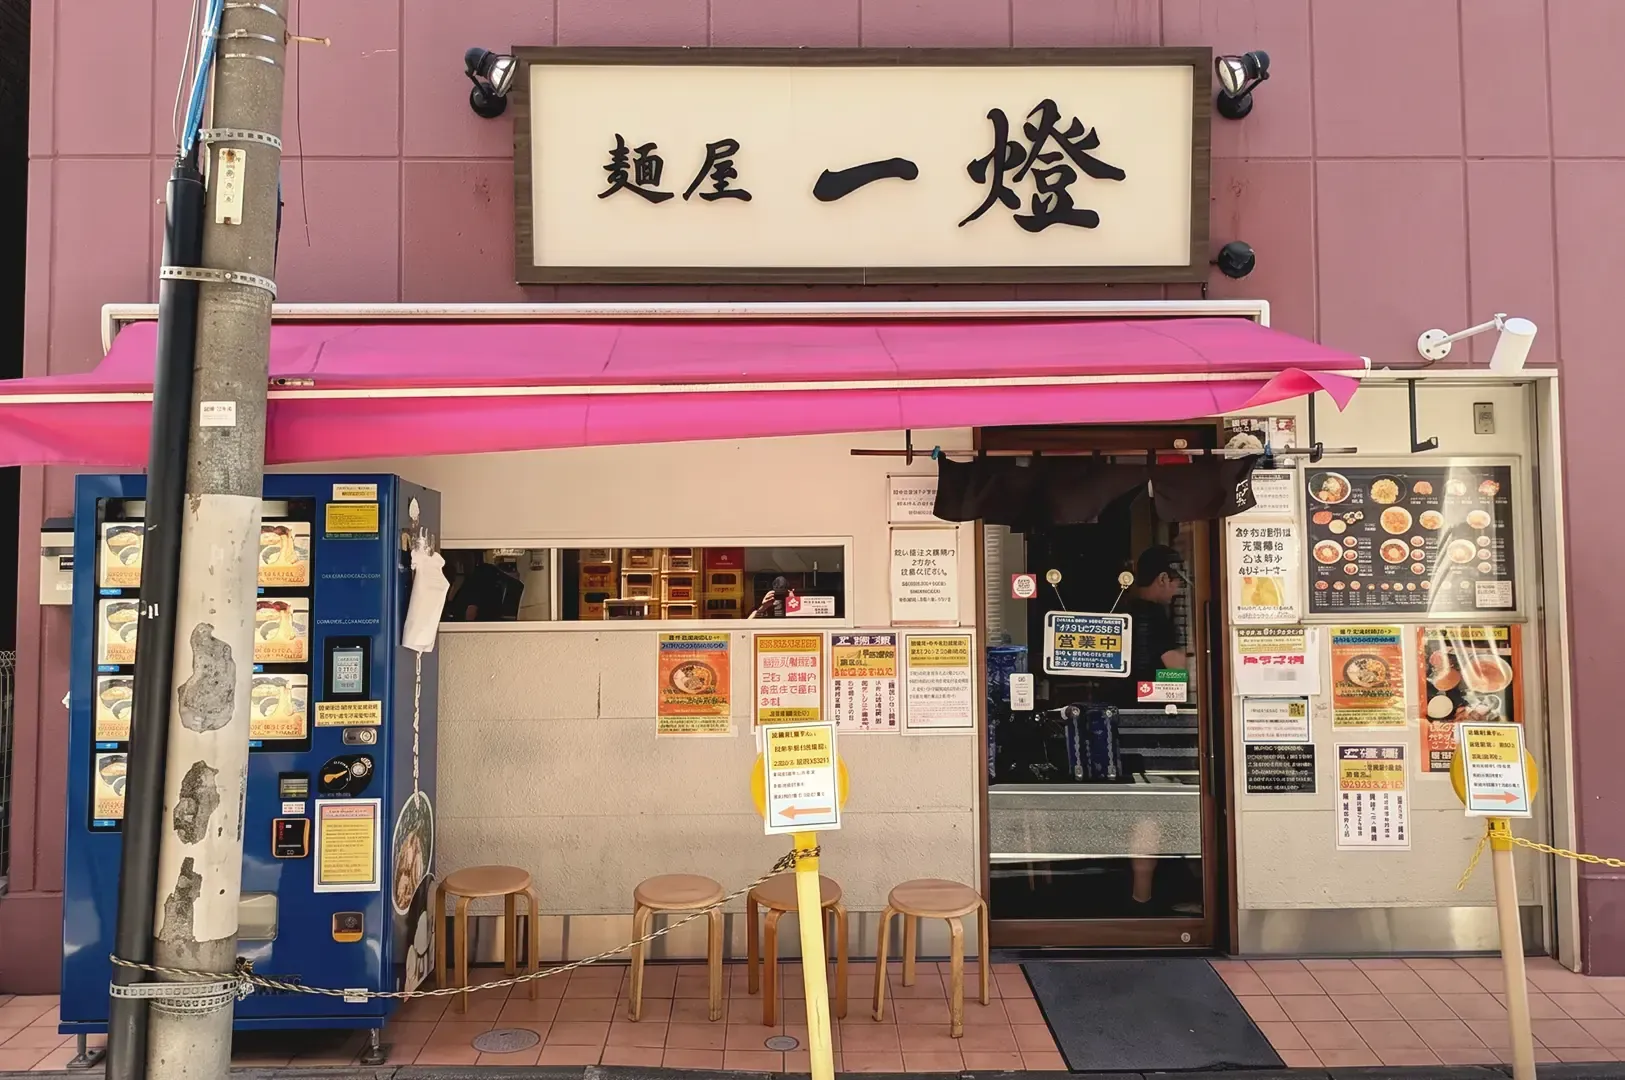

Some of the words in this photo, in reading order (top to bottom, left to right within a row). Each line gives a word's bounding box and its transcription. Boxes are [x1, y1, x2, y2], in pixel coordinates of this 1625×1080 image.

[597, 133, 752, 204] 麺屋
[1058, 634, 1117, 650] 営業中
